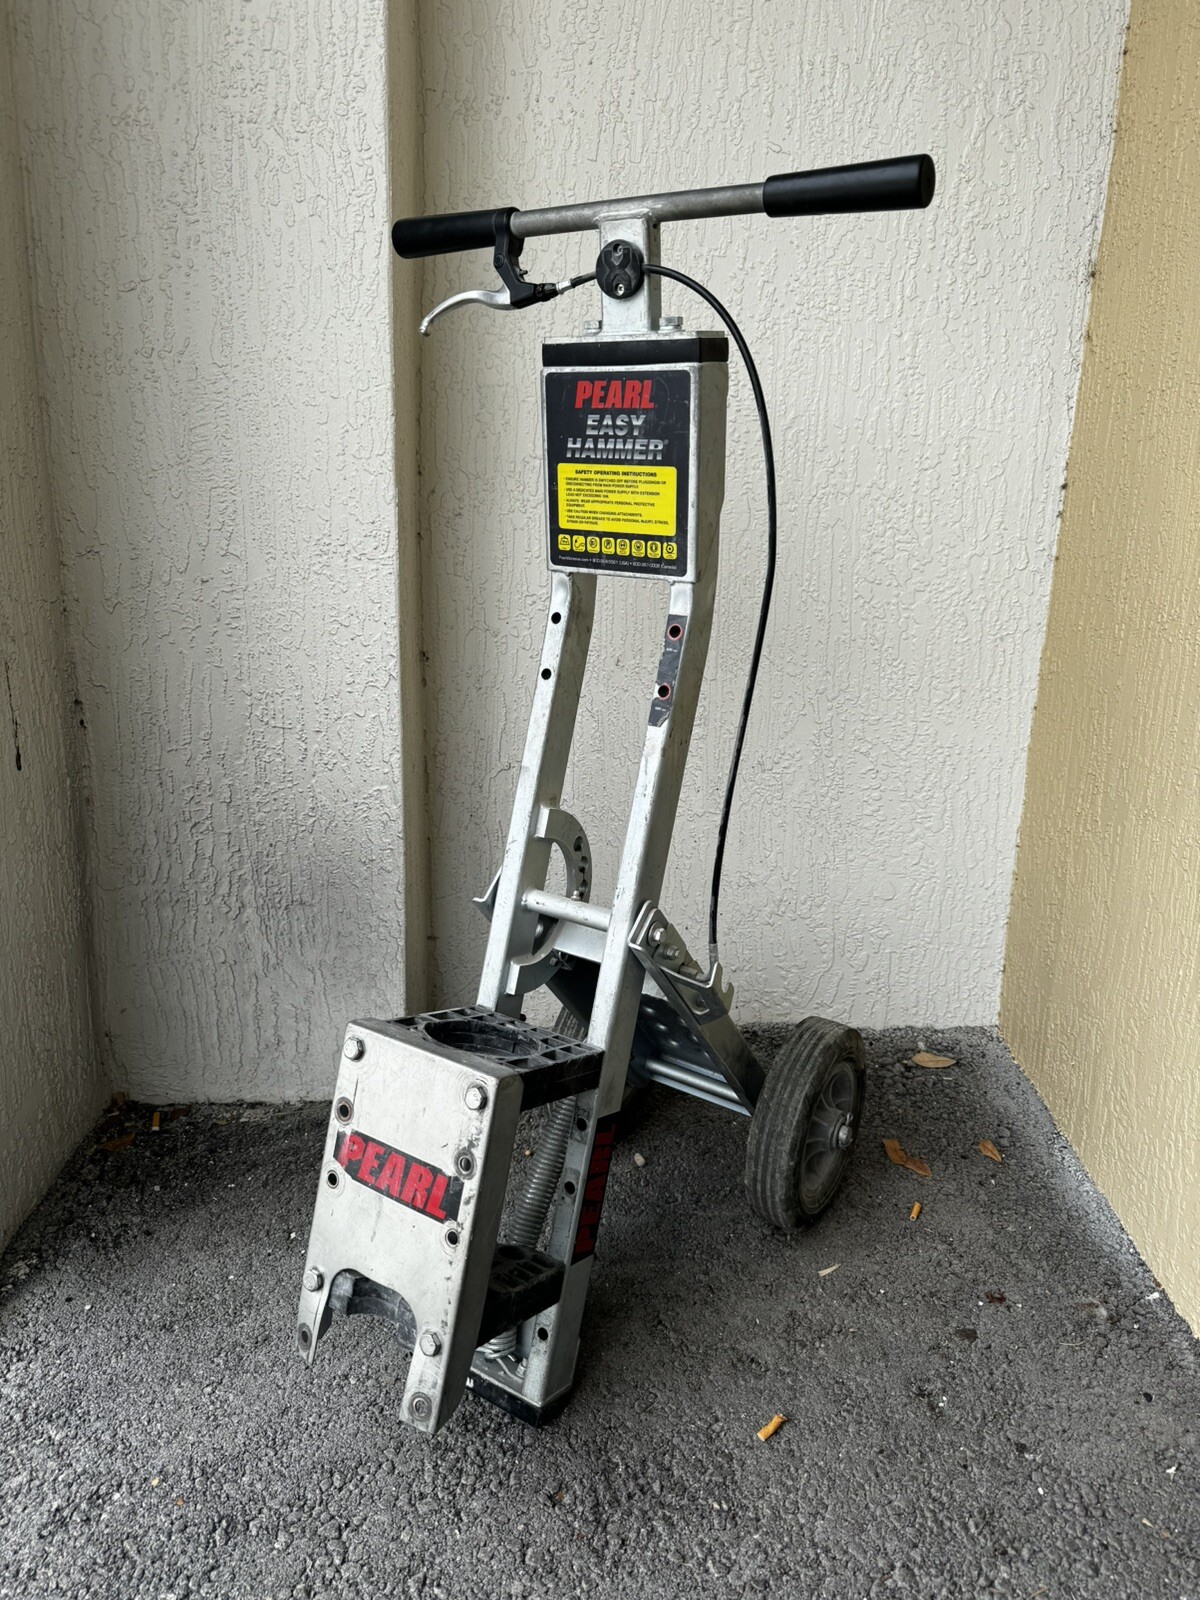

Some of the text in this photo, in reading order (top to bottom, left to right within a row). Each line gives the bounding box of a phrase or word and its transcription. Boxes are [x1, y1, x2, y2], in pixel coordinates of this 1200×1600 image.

[574, 379, 655, 410] PEARL
[586, 414, 646, 436] EASY
[337, 1133, 449, 1220] PEARL
[574, 1122, 617, 1253] PEARL
